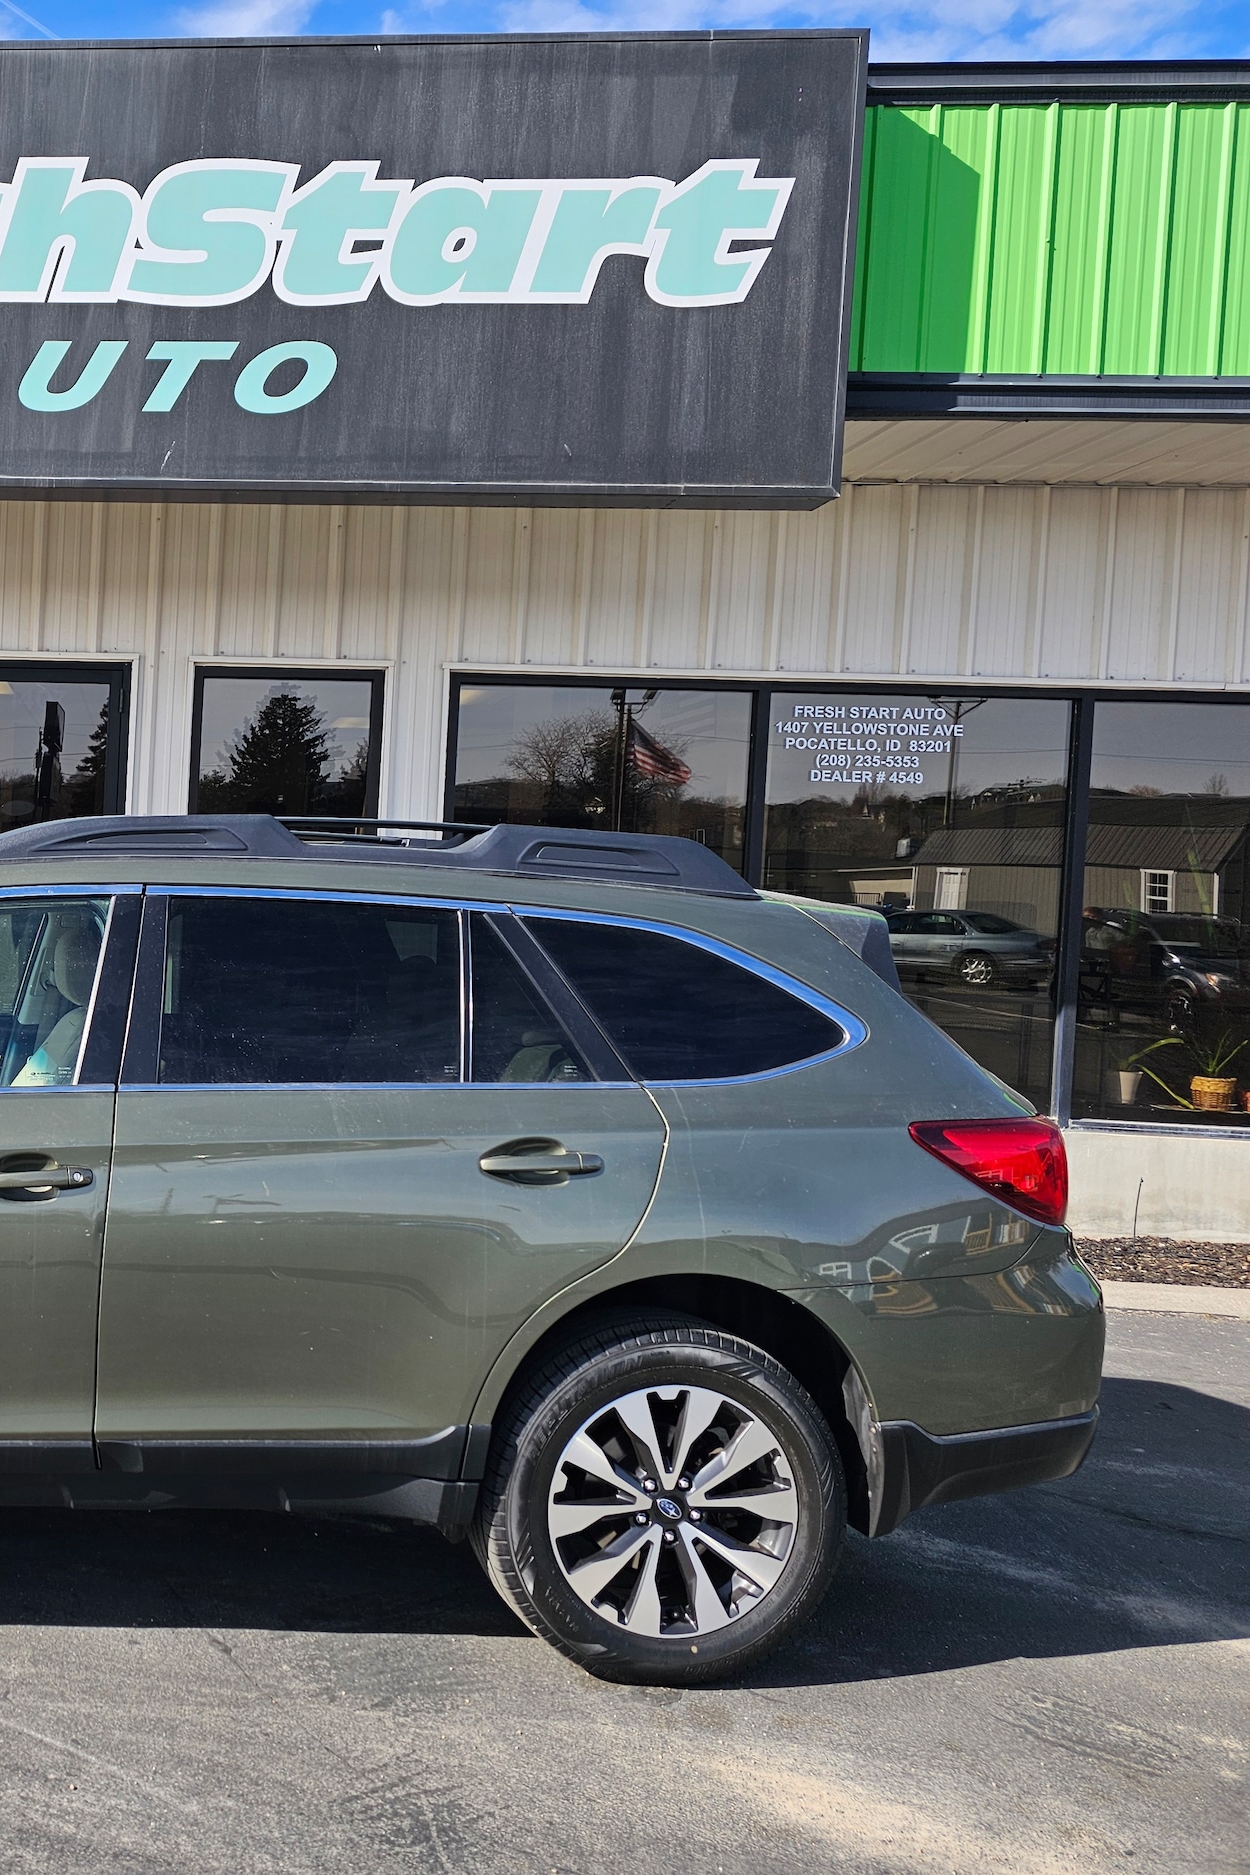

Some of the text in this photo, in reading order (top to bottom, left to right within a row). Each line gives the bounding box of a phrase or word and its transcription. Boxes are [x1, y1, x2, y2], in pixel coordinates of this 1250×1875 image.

[793, 705, 947, 721] FRESH START AUTO
[774, 721, 964, 737] 1407 YELLOWSTONE AVE
[785, 737, 951, 753] POCATELLO, ID 83201
[815, 753, 920, 769] (208) 235-5353
[809, 769, 924, 784] DEALER # 4549
